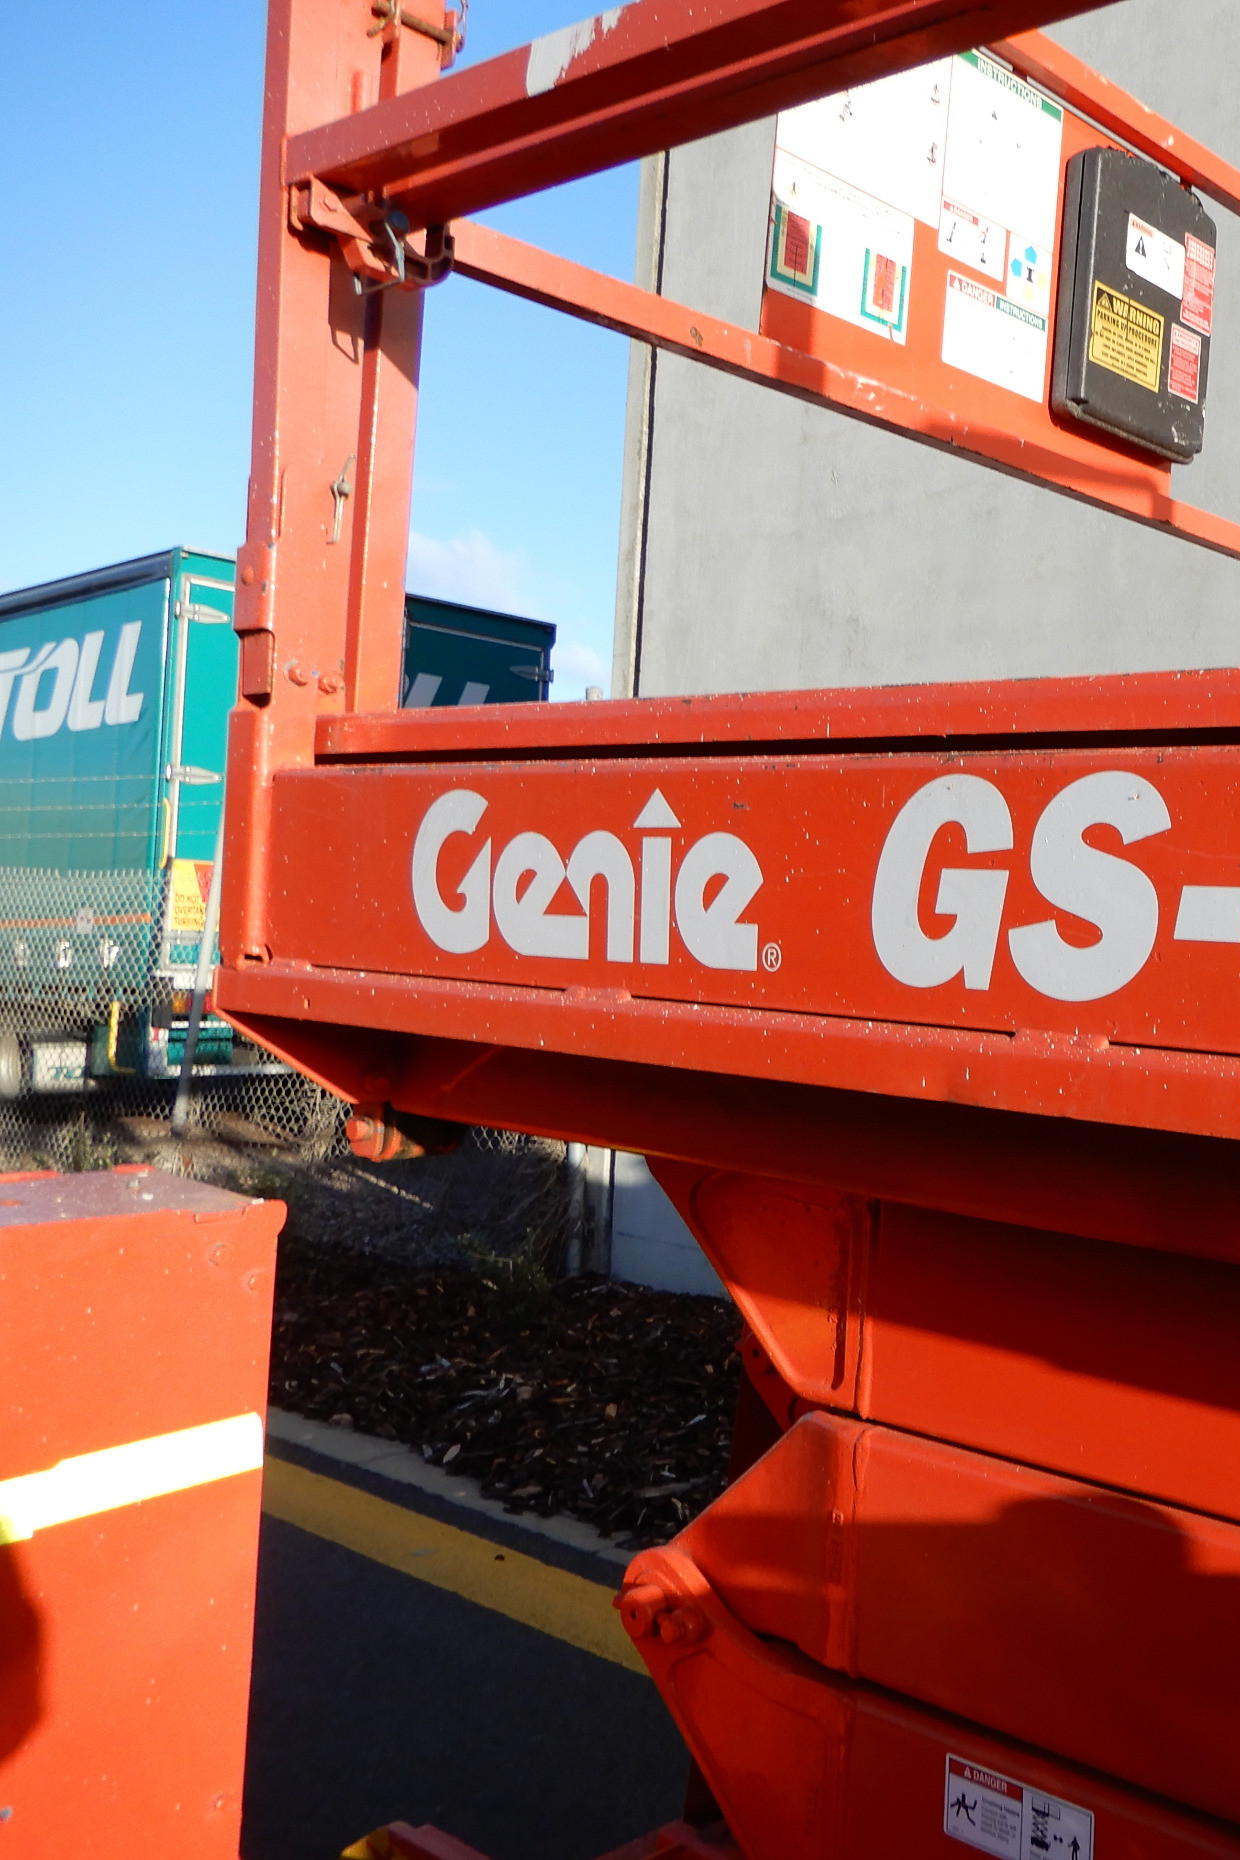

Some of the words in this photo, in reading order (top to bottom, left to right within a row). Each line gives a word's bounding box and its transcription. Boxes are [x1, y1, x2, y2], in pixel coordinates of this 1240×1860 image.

[977, 57, 1043, 110] INSTRUCTIONS
[961, 282, 994, 308] DANGER
[999, 299, 1043, 330] INSTRUCTIONS
[1096, 309, 1120, 329] PARKING
[1128, 326, 1158, 348] PROCEDURE
[1112, 296, 1160, 336] WARNING
[0, 620, 145, 742] TOLL
[411, 787, 765, 972] Genie
[973, 1768, 1008, 1794] DANGER
